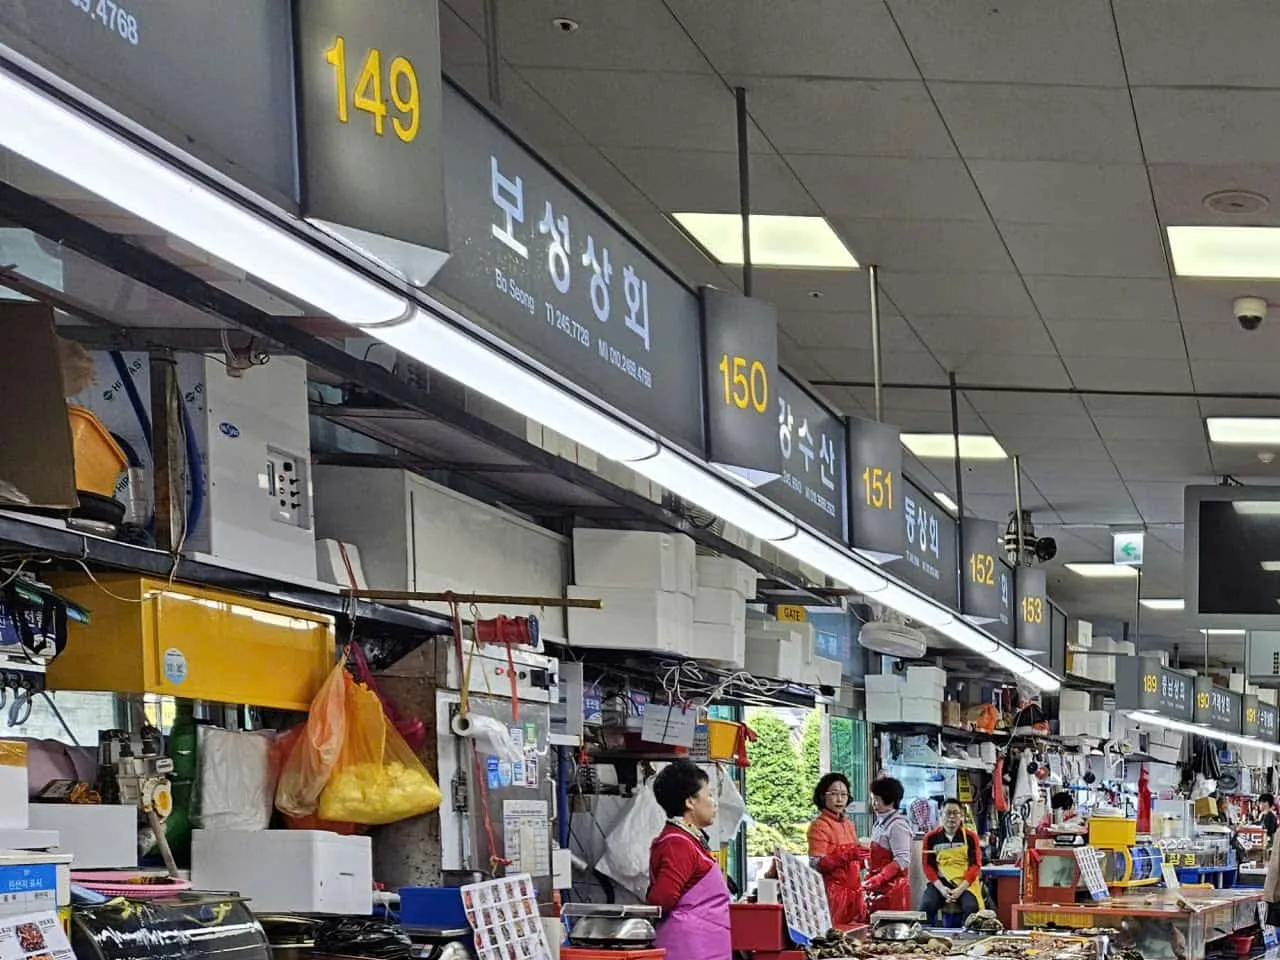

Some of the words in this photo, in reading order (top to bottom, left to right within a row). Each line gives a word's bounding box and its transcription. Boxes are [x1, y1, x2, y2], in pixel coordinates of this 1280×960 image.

[326, 36, 420, 142] 149
[490, 155, 650, 351] 보성상회
[495, 267, 508, 293] Bo
[509, 279, 535, 315] Seong
[719, 352, 769, 414] 150
[862, 465, 893, 511] 151
[970, 553, 995, 585] 152
[1022, 597, 1042, 623] 153
[1143, 674, 1158, 692] 189
